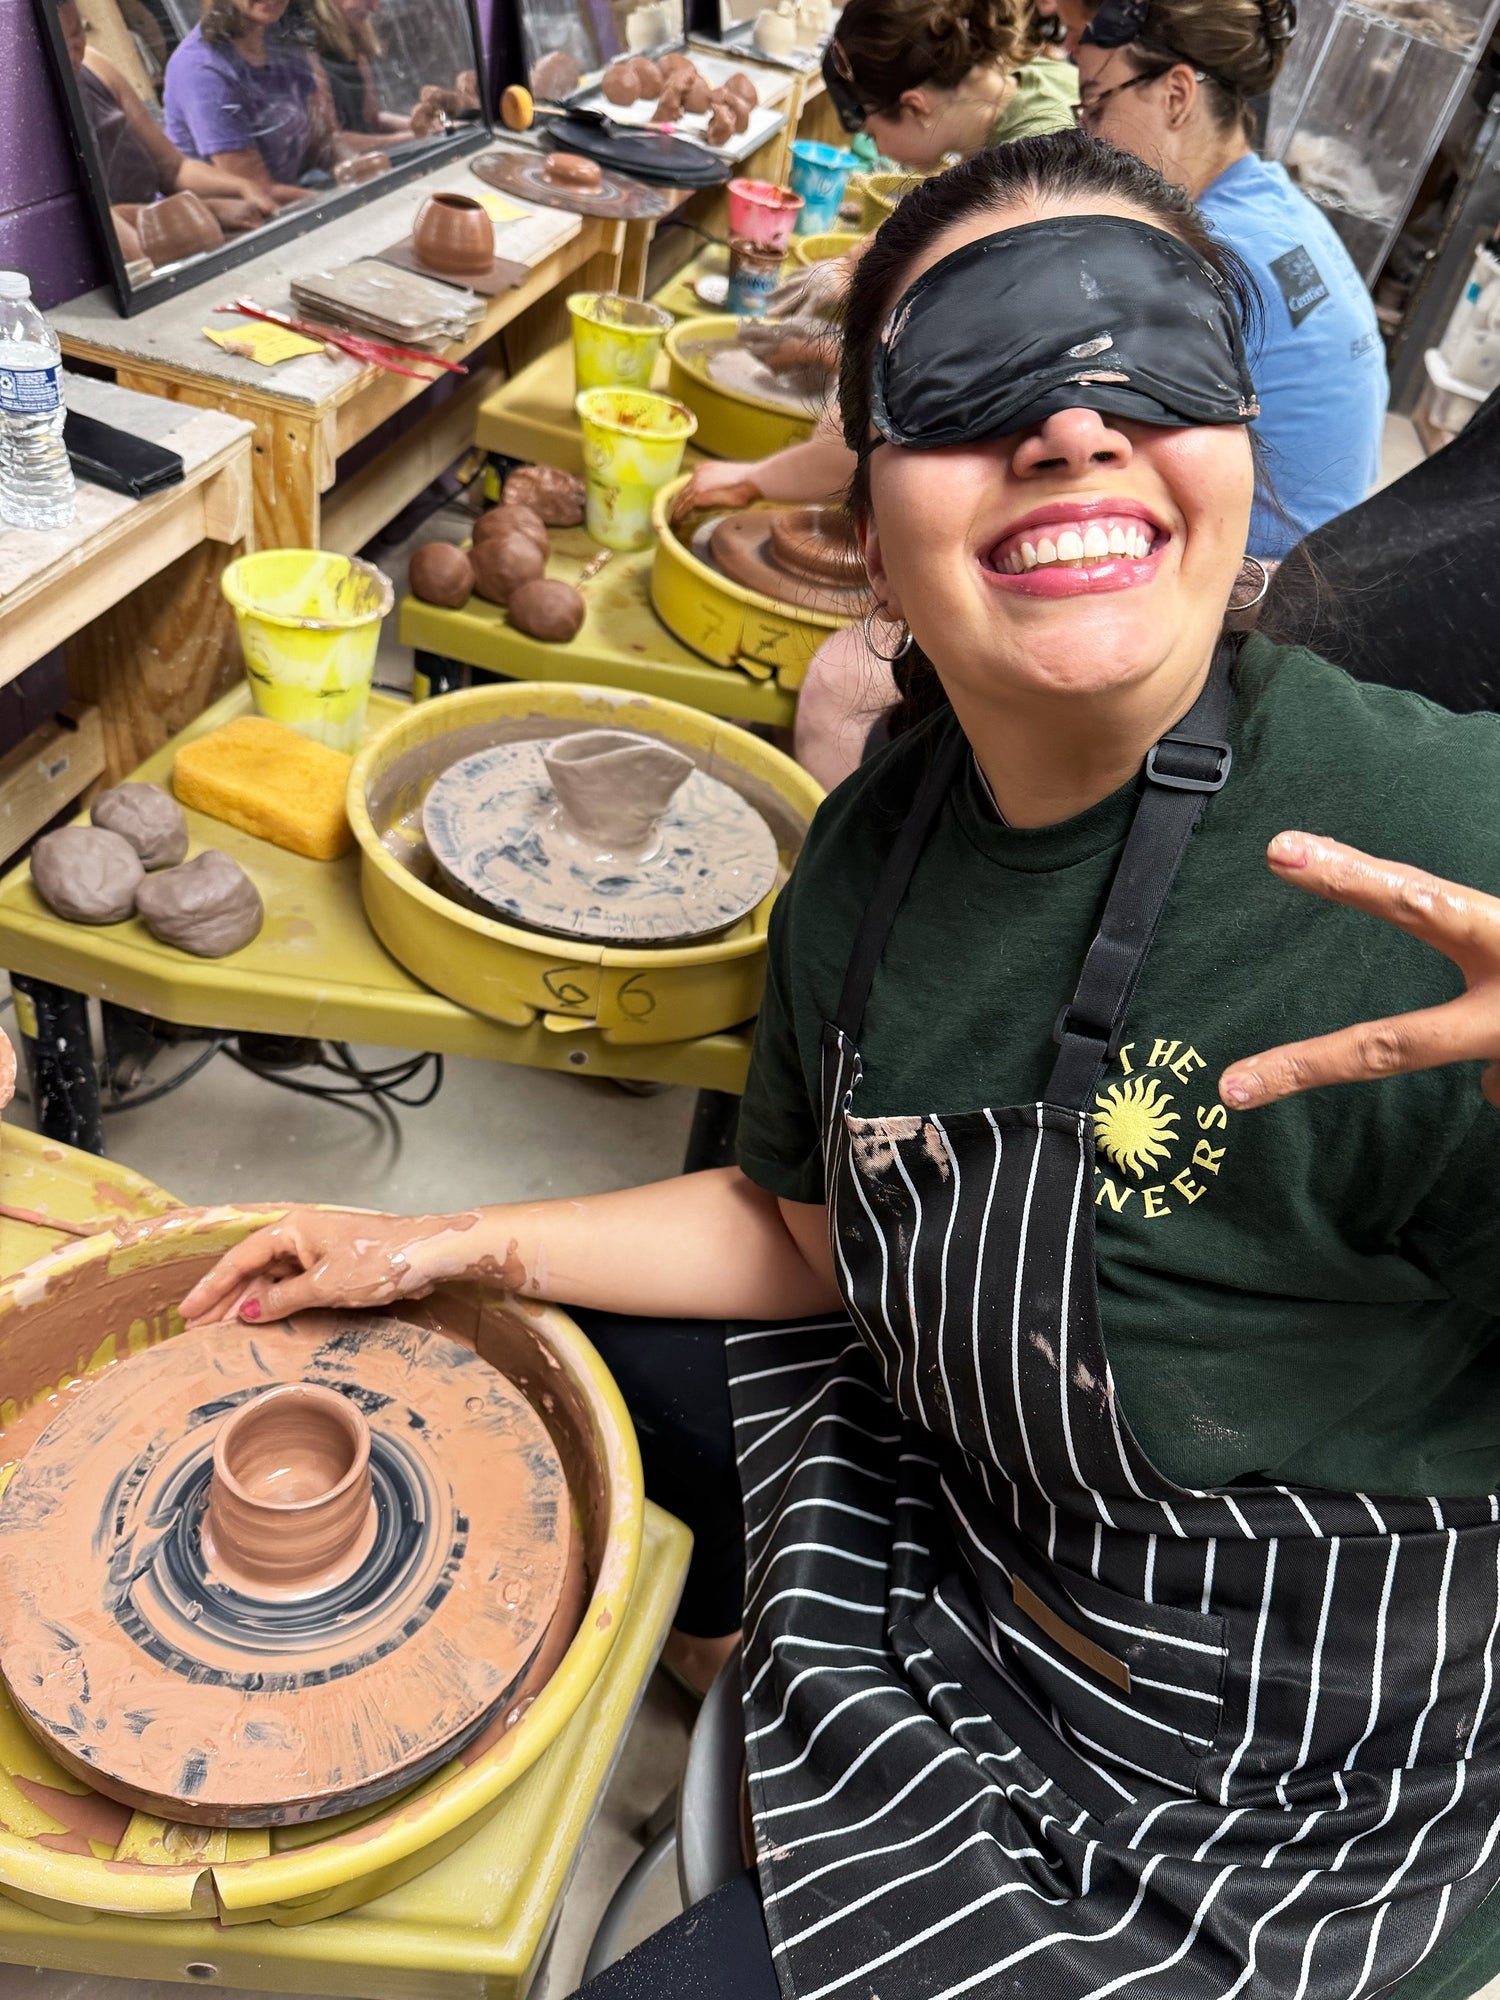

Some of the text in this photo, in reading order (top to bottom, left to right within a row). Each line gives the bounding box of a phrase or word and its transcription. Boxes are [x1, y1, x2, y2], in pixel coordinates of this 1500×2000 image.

[543, 966, 656, 1017] 6 6
[1094, 1104, 1228, 1219] NEERS
